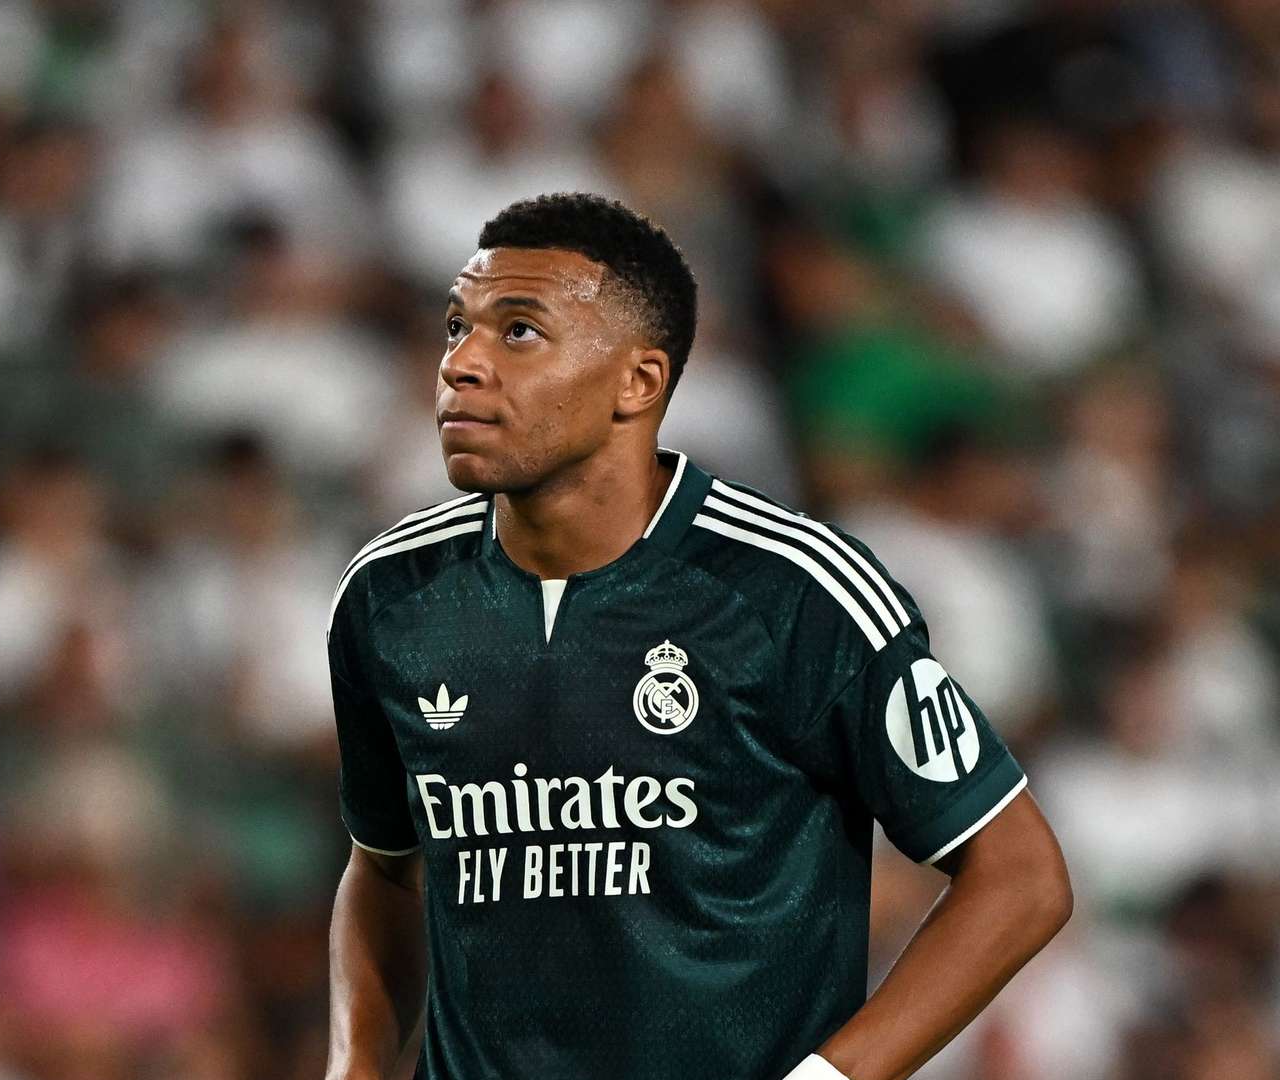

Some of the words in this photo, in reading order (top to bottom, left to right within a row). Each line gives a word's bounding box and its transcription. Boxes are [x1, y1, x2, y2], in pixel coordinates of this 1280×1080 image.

[901, 660, 968, 780] hp
[415, 762, 699, 839] Emirates
[457, 847, 508, 905] FLY
[522, 841, 651, 900] BETTER
